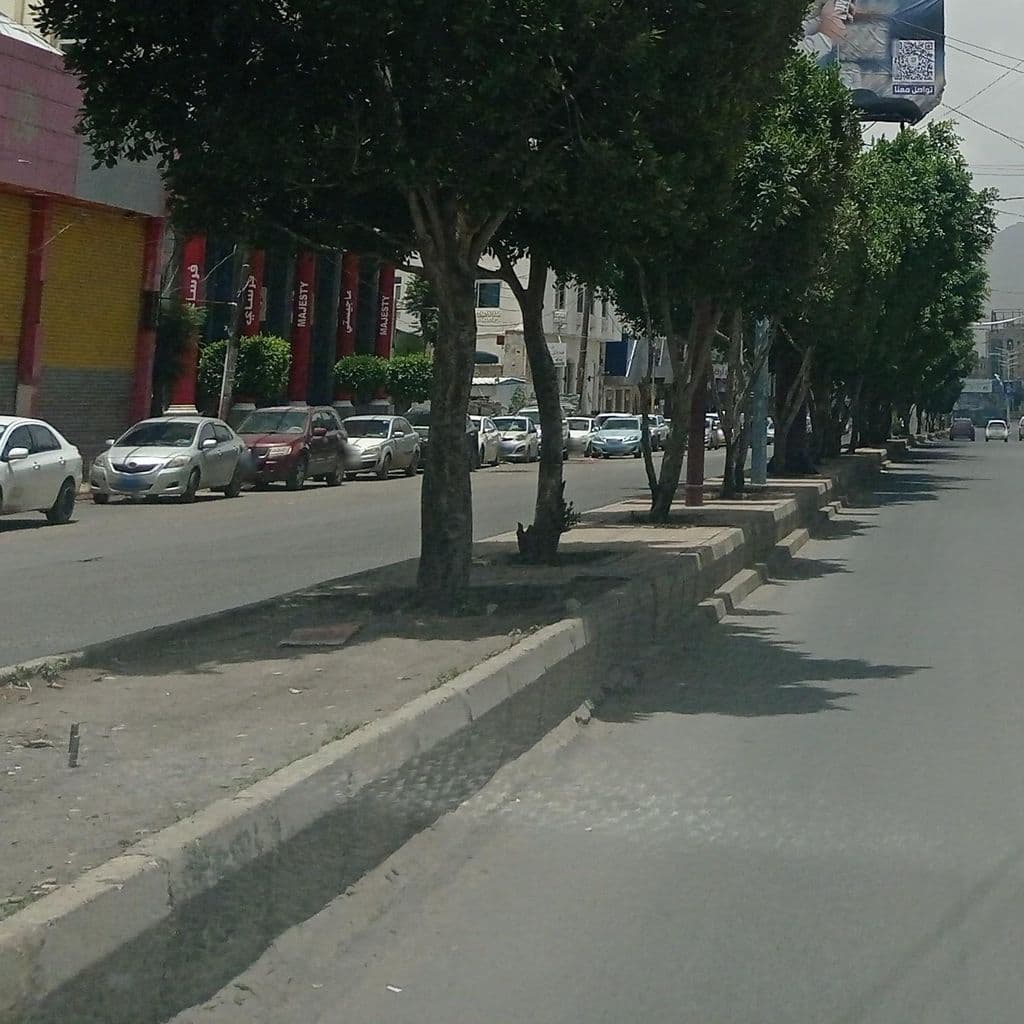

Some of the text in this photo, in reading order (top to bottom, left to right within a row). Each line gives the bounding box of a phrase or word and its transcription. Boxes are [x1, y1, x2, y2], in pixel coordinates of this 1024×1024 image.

[911, 86, 933, 95] تواصل
[187, 263, 200, 307] فرسا
[297, 280, 310, 328] MAJESTY
[379, 294, 390, 336] MAJESTY
